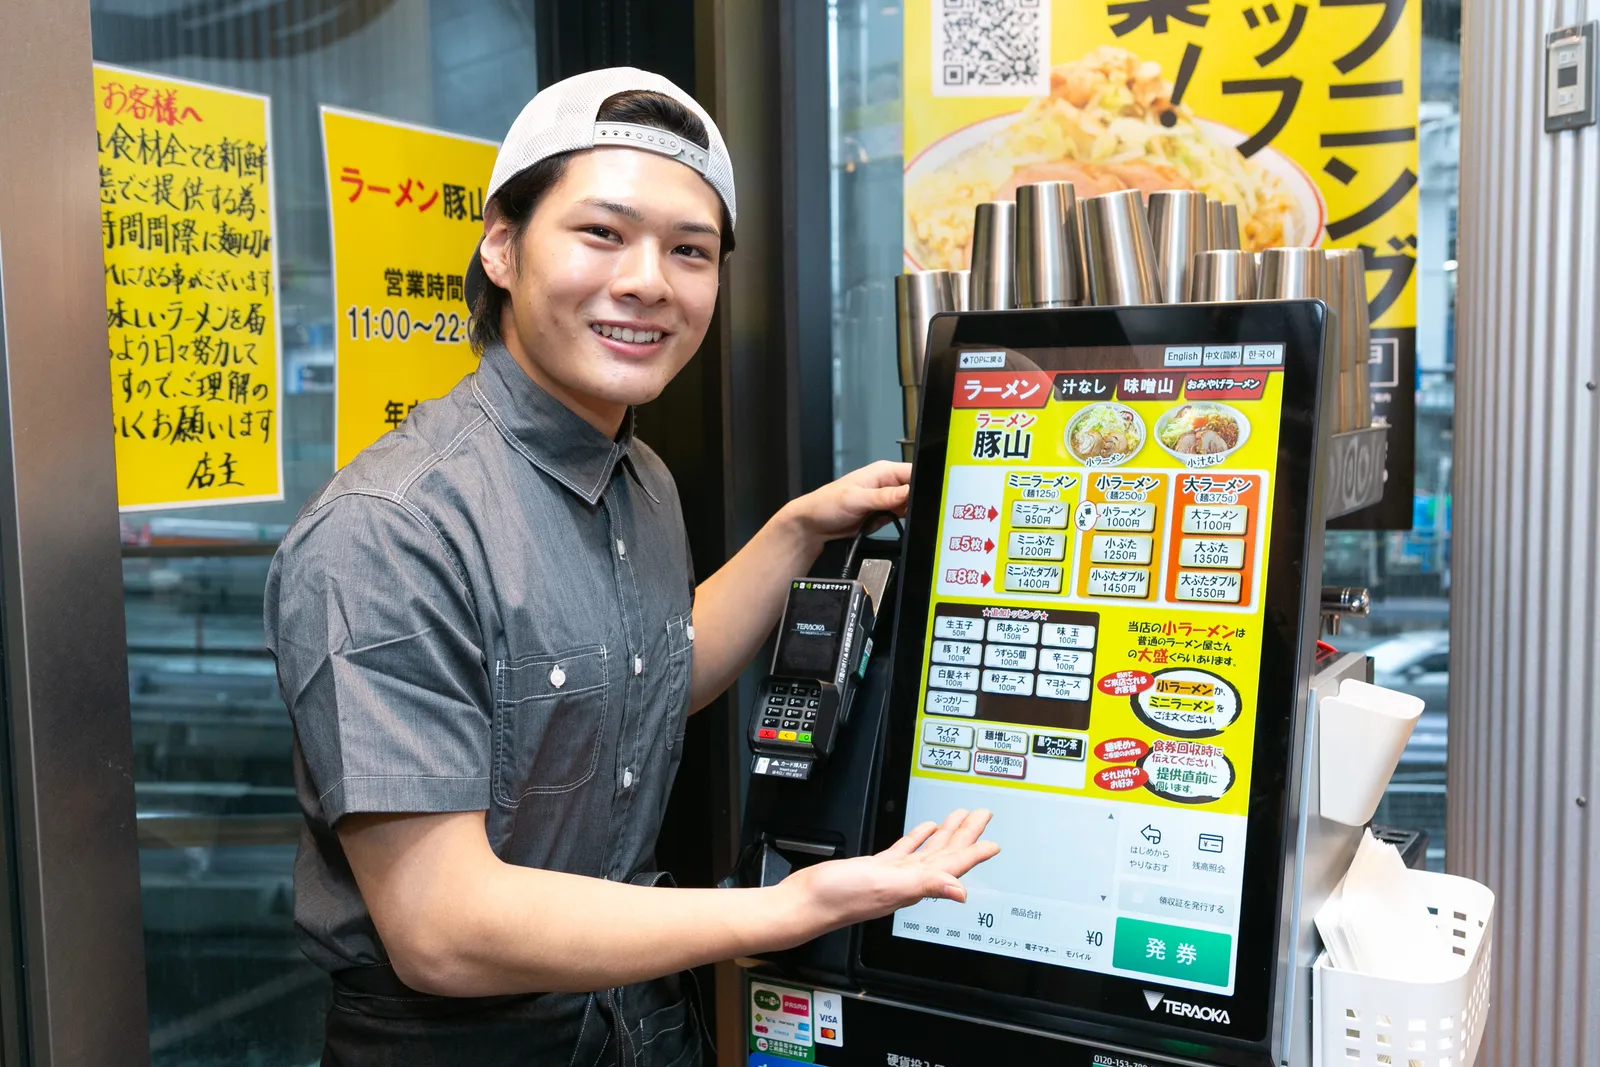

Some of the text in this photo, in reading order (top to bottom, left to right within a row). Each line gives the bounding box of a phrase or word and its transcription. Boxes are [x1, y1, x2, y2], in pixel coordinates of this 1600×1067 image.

[101, 82, 203, 126] お客様へ
[97, 122, 268, 185] 食材全てを新鮮
[340, 166, 484, 223] ラーメン豚山
[384, 268, 464, 302] 営業時間
[969, 356, 1003, 365] TOPに戻る
[1167, 351, 1198, 362] English
[1248, 349, 1275, 360] 한국어
[964, 379, 1041, 401] ラーメン
[1061, 378, 1107, 395] 汁なし
[1123, 377, 1174, 395] 味噌山
[1187, 379, 1260, 391] おみやげラーメン
[114, 405, 274, 445] しくお願いします
[977, 413, 1035, 429] ラーメン
[973, 429, 1031, 460] 豚山
[1086, 453, 1125, 468] 小ラーメン
[1187, 454, 1224, 468] 小汁なし
[186, 452, 245, 490] 店主
[1008, 473, 1077, 489] ミニラーメン
[1096, 474, 1159, 491] 小ラーメン
[1184, 476, 1251, 493] 大ラーメン
[953, 504, 985, 520] 豚2枚
[1015, 503, 1063, 514] ミニラーメン
[1102, 507, 1147, 518] 小ラーメン
[1191, 508, 1239, 520] 大ラーメン
[1025, 515, 1051, 525] 950円
[1106, 517, 1140, 528] 1000円
[1195, 520, 1231, 531] 1100円
[949, 535, 982, 552] 豚5枚
[1017, 534, 1055, 546] ミニぶた
[1105, 538, 1137, 549] 小ぶた
[1019, 546, 1052, 557] 1200円
[1195, 541, 1229, 553] 大ぶた
[1103, 550, 1137, 560] 1250円
[1192, 553, 1229, 564] 1350円
[945, 568, 980, 585] 豚8枚
[1007, 565, 1059, 578] ミニぶたダブル
[1091, 569, 1145, 582] 小ぶたダブル
[1017, 578, 1050, 589] 1400円
[1181, 574, 1237, 587] 大ぶたダブル
[1102, 583, 1136, 593] 1450円
[1190, 587, 1226, 598] 1550円
[991, 608, 1041, 621] 追加トッピング
[796, 622, 825, 631] TERAOKA
[945, 620, 973, 630] 生玉子
[996, 623, 1030, 634] 肉あぶら
[1127, 620, 1246, 639] 当店の小ラーメンは
[952, 629, 966, 637] 50円
[1003, 633, 1021, 641] 150円
[1058, 637, 1077, 645] 100円
[1137, 635, 1232, 651] 普通のラーメン屋さん
[948, 654, 965, 662] 100円
[994, 649, 1027, 660] うずら5個
[1052, 652, 1079, 663] 辛ニラ
[1127, 647, 1237, 667] の大盛くらいあります。
[1000, 659, 1019, 667] 100円
[1056, 663, 1075, 671] 100円
[945, 679, 963, 687] 100円
[991, 673, 1026, 685] 粉チーズ
[1045, 678, 1081, 689] マヨネーズ
[1103, 677, 1147, 688] ご来店される
[998, 684, 1016, 692] 100円
[1055, 688, 1070, 696] 50円
[942, 704, 960, 713] 100円
[1153, 711, 1216, 726] ご注文ください。
[936, 726, 960, 736] ライス
[938, 735, 956, 744] 150円
[993, 741, 1012, 750] 100円
[1037, 735, 1078, 750] 黒ウーロン茶
[928, 748, 961, 760] 大ライス
[1046, 747, 1067, 757] 200円
[1153, 740, 1223, 758] 食券回収時に
[934, 759, 953, 767] 200円
[1151, 753, 1217, 769] 伝えてください。
[989, 765, 1009, 774] 500円
[1101, 767, 1140, 781] それ以外の
[1156, 766, 1217, 785] 提供直前に
[1110, 779, 1134, 789] お好み
[1155, 781, 1194, 794] 伺います。
[1130, 846, 1170, 859] はじめから
[1129, 859, 1169, 873] やりなおす
[1191, 860, 1226, 874] 残高照会
[1159, 895, 1225, 914] 領収証を発行する
[1010, 906, 1042, 920] 商品合計
[977, 911, 994, 928] ¥0
[903, 921, 1092, 961] 10000 5000 2000 1000 クレジット 電子マネー モバイル
[1085, 929, 1103, 947] ¥0
[1163, 999, 1231, 1025] TERAOKA
[819, 1013, 838, 1024] VISA
